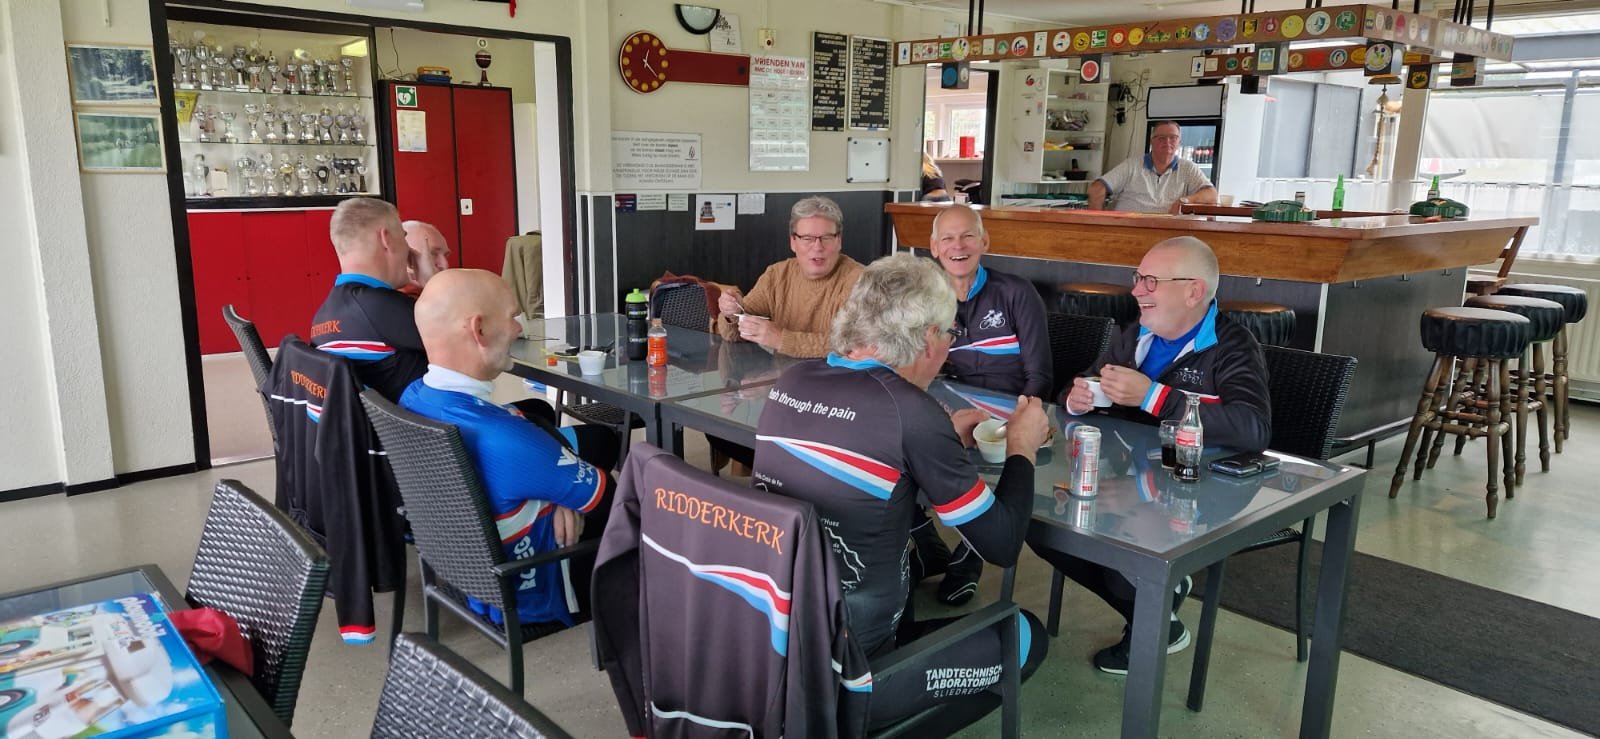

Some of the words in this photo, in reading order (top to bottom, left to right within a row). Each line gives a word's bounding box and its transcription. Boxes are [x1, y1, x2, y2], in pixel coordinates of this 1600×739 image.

[754, 57, 790, 68] VRIENDEN
[791, 60, 806, 69] VAN
[778, 392, 812, 413] through
[812, 402, 829, 415] the
[827, 407, 857, 421] pain
[654, 488, 785, 555] RIDDERKERK
[926, 674, 1000, 691] LABORATORIUM
